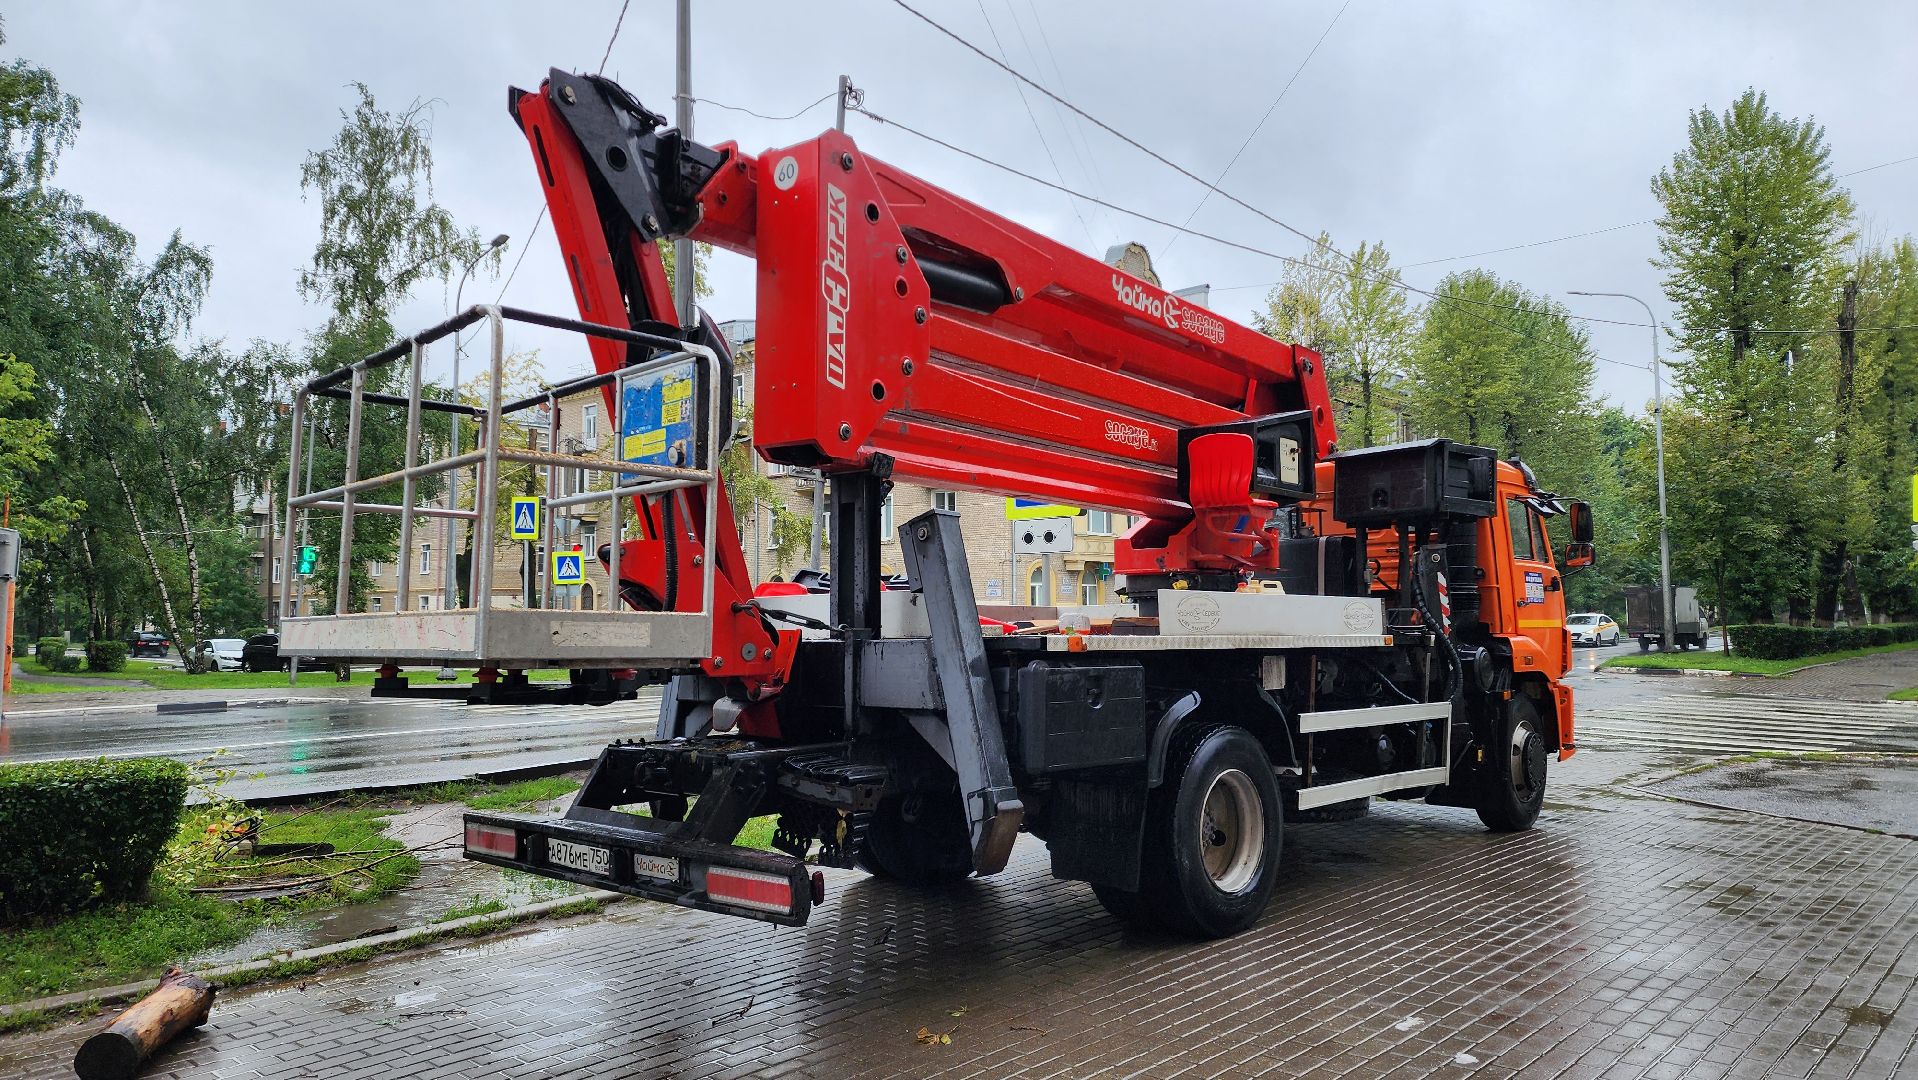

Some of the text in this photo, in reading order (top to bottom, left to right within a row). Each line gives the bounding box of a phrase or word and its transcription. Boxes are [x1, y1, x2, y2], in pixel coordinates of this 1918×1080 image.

[777, 162, 795, 182] 60
[1112, 273, 1161, 318] Чайка
[589, 847, 609, 865] 750
[635, 857, 666, 875] Чайка
